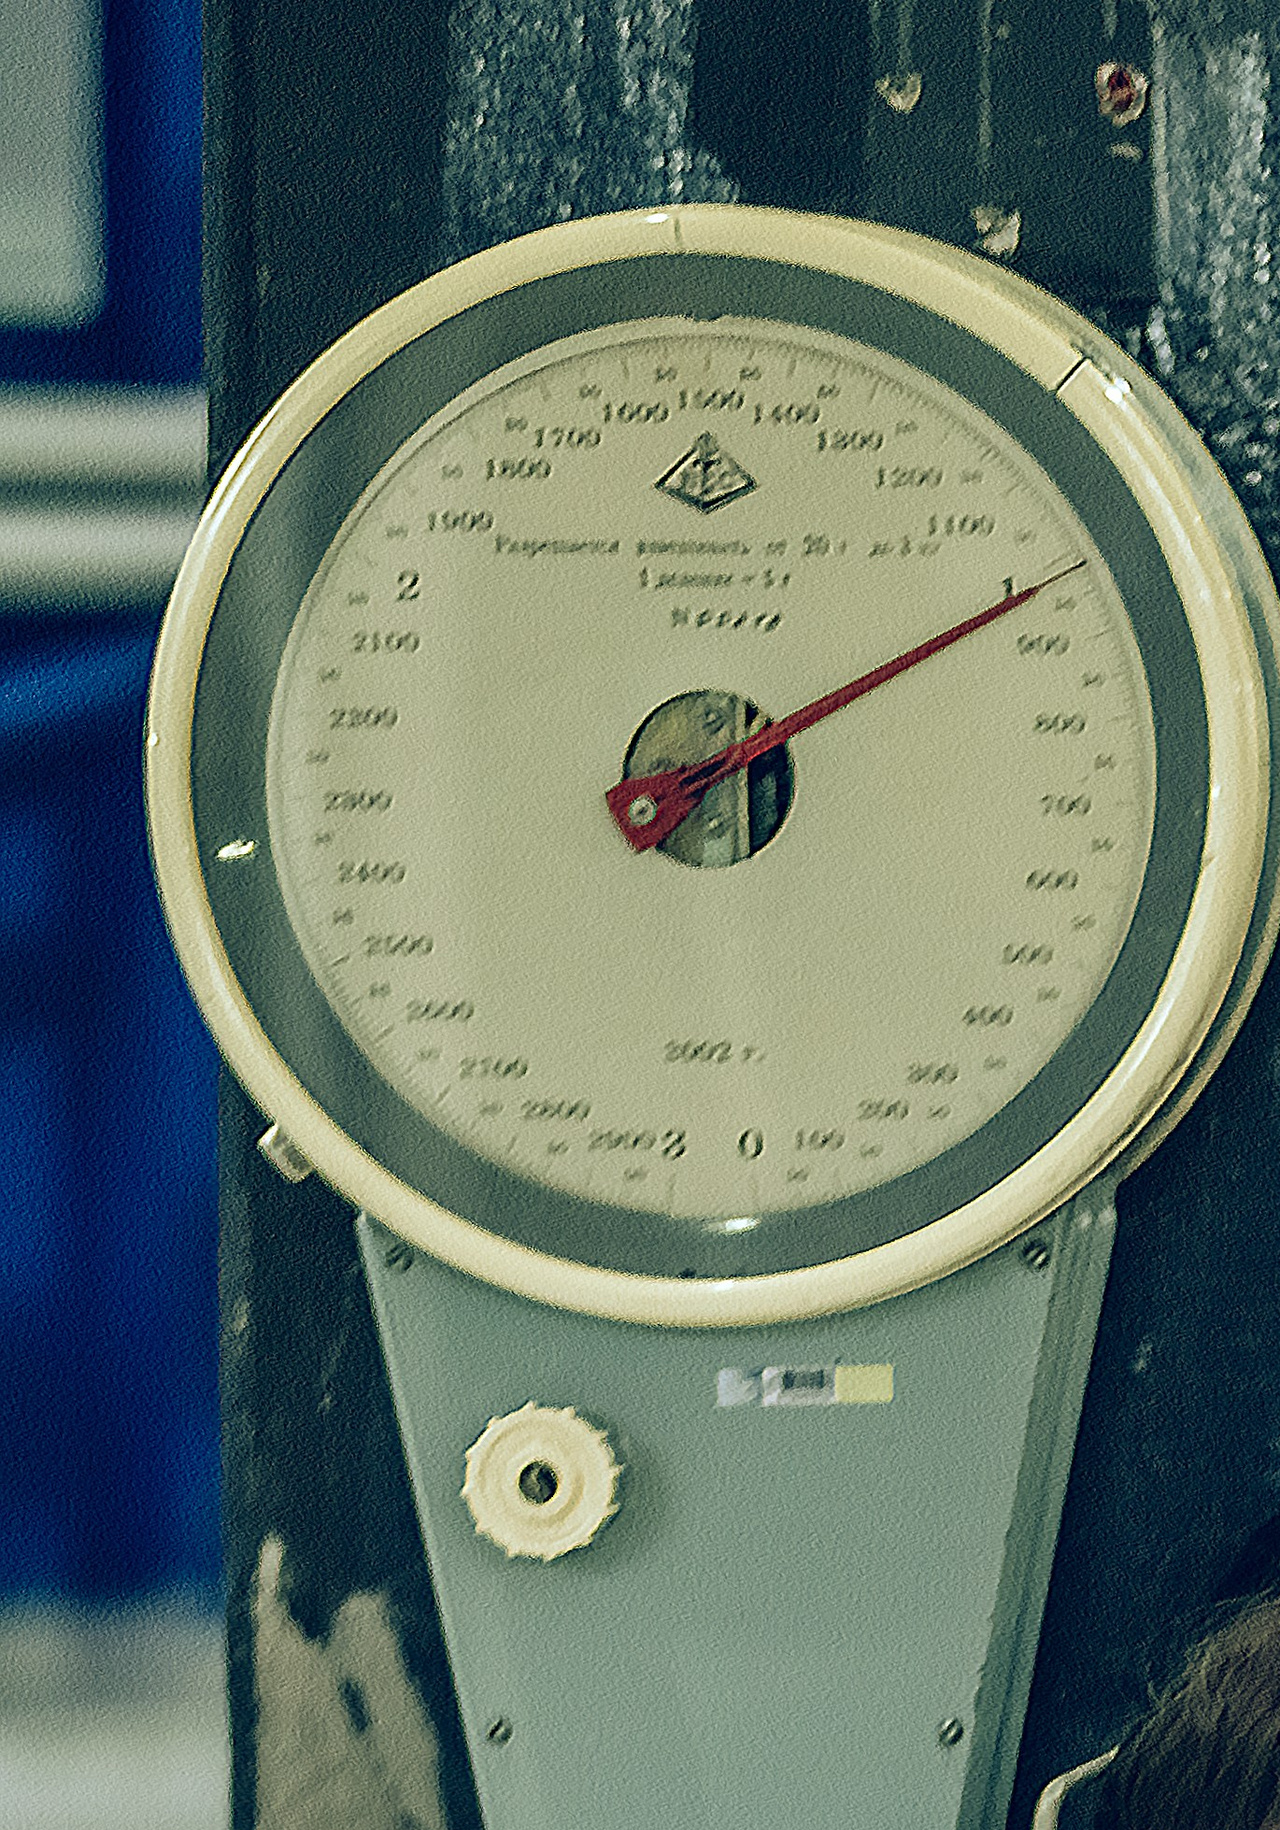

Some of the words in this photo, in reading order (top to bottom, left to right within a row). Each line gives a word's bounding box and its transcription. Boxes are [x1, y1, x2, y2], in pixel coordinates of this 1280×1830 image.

[927, 513, 995, 537] 1100
[395, 569, 421, 602] 2
[1002, 576, 1015, 598] 1
[661, 1128, 687, 1161] 3
[737, 1128, 764, 1162] 0
